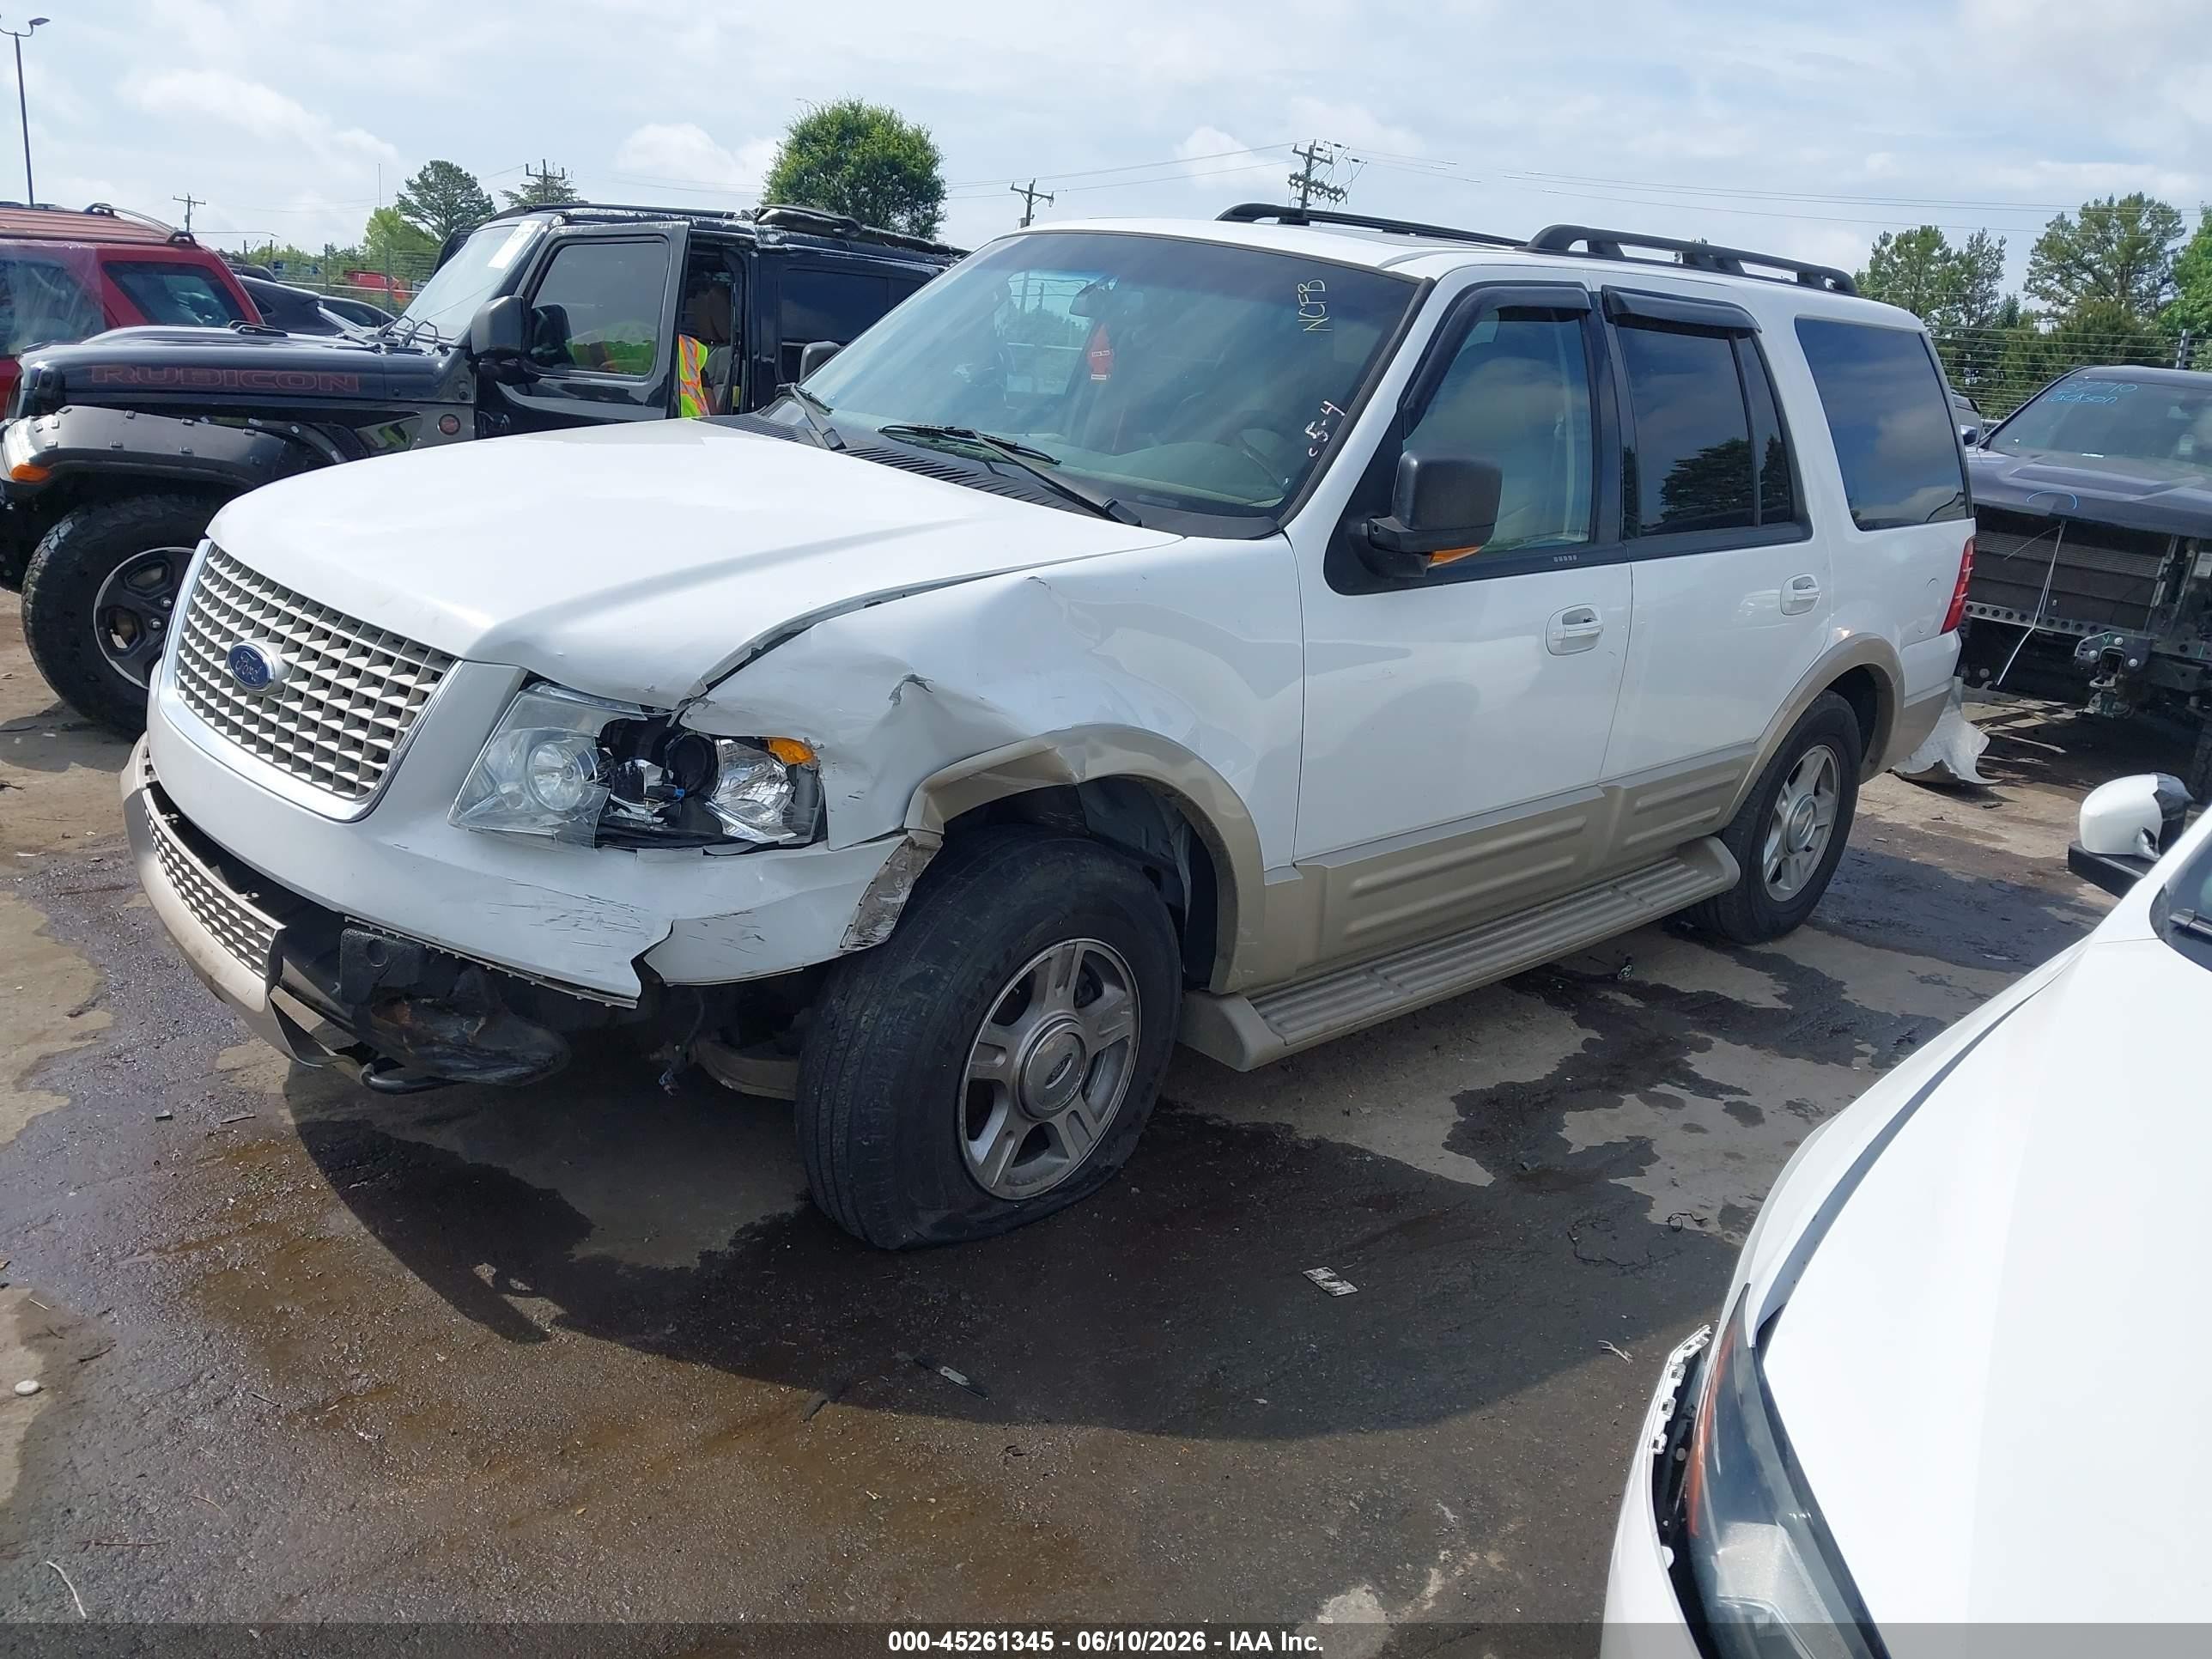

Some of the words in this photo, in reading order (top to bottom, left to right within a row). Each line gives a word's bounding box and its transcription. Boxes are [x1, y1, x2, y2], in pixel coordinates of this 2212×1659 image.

[1297, 279, 1333, 331] NCFB
[90, 364, 360, 392] RUBICON
[2042, 391, 2118, 404] Jackson
[233, 648, 266, 685] Ford
